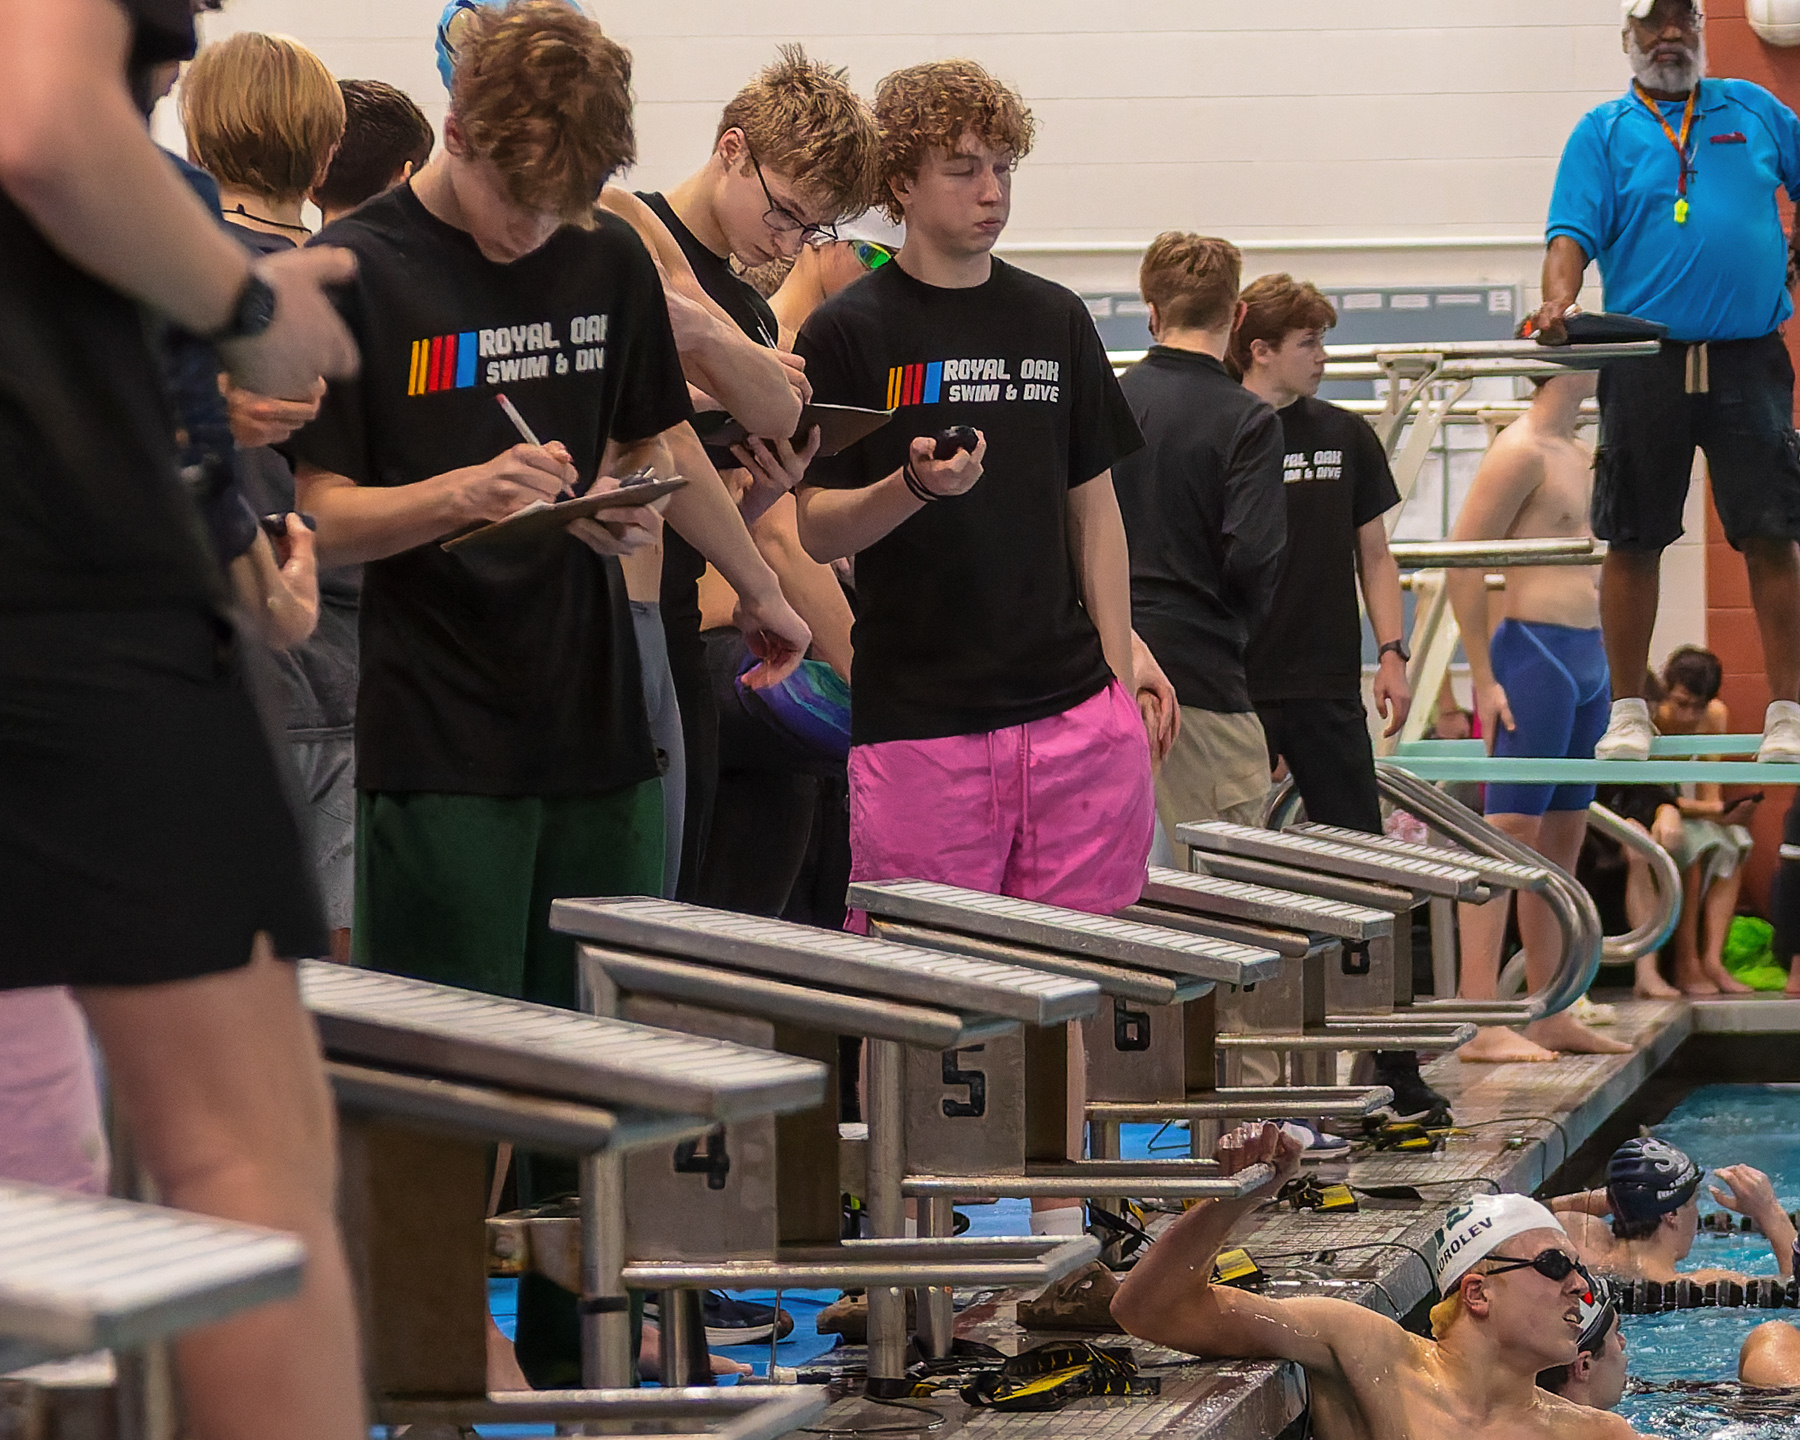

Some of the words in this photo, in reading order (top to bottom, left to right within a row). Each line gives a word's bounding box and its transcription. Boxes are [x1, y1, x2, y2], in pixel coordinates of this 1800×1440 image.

[479, 322, 561, 358] ROYAL
[486, 355, 550, 384] SWIM
[555, 352, 569, 375] &
[575, 347, 605, 372] DIV
[943, 358, 1011, 382] ROYAL
[1020, 358, 1060, 382] OAK
[949, 383, 1000, 402] SWIM
[1005, 383, 1018, 401] &
[1023, 383, 1060, 403] DIVE
[1113, 995, 1151, 1052] 6
[942, 1043, 986, 1118] 5
[673, 1121, 730, 1190] 4
